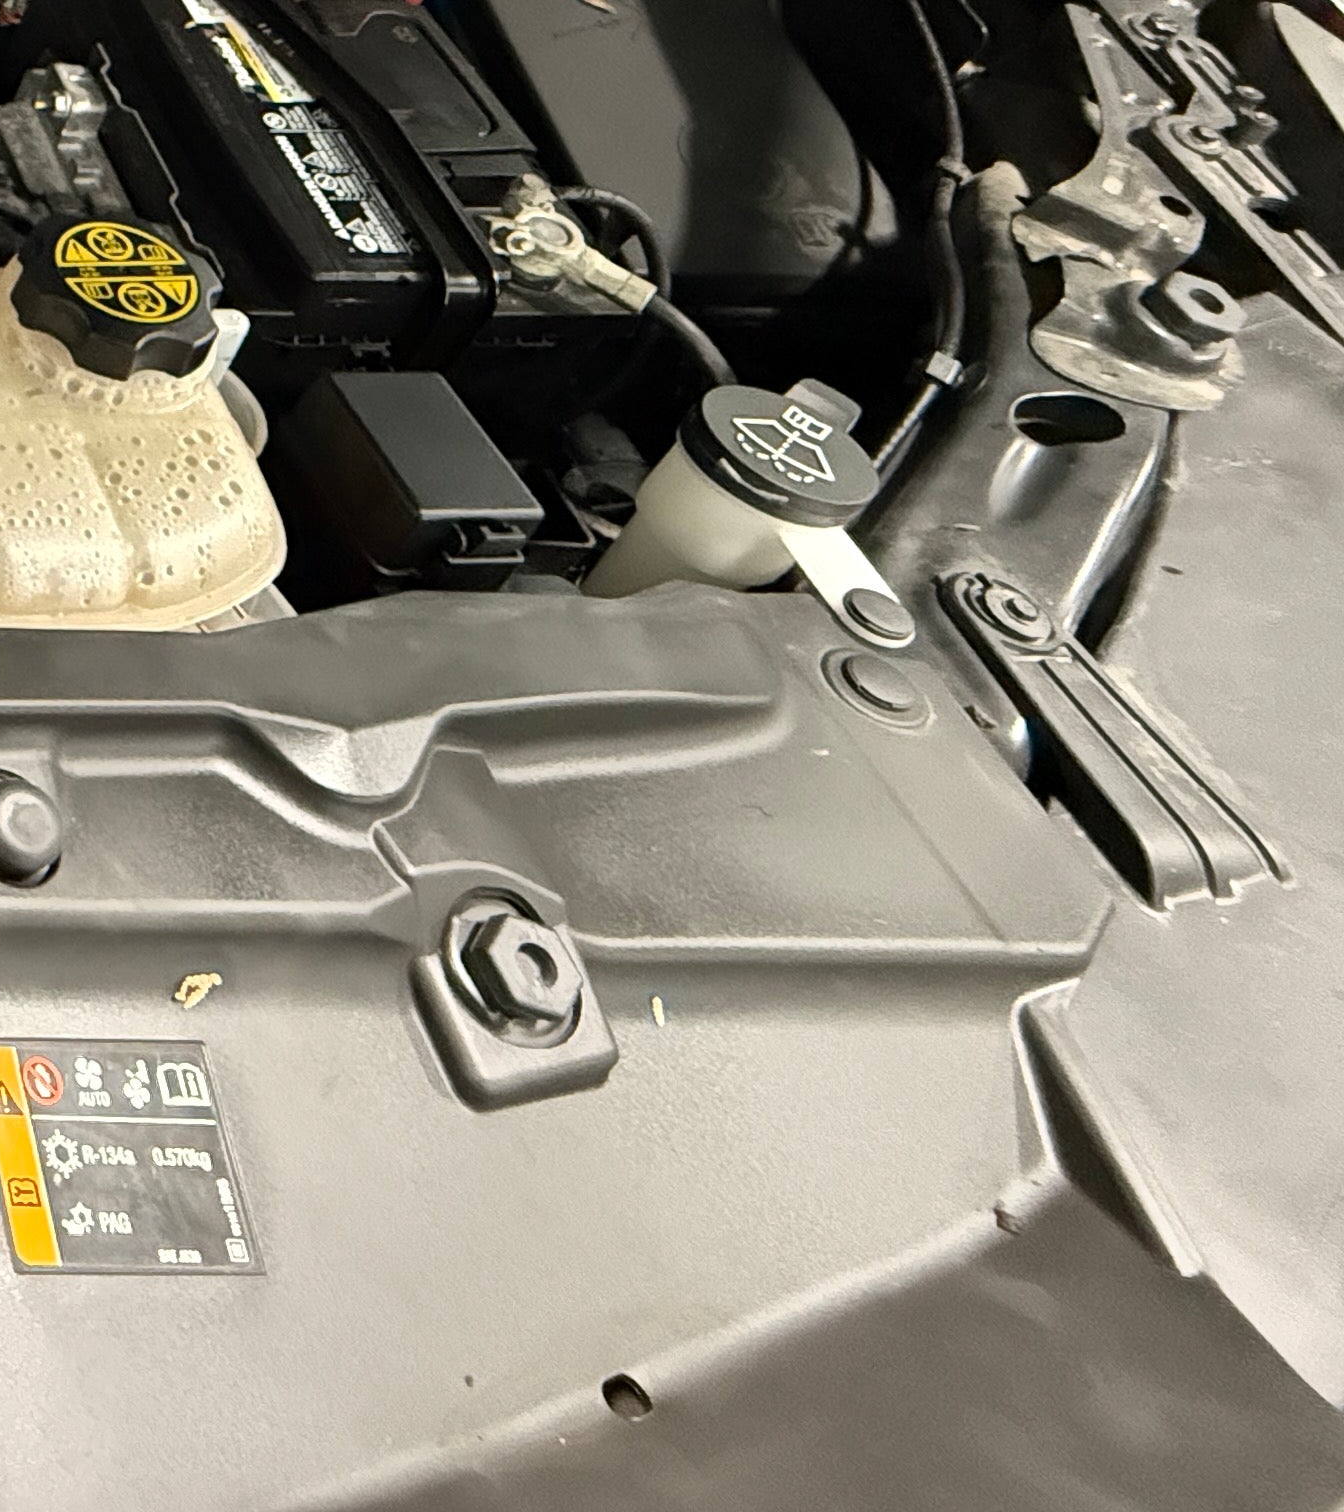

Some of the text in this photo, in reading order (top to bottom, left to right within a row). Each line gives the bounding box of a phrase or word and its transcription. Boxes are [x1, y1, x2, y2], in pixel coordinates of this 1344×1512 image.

[78, 1090, 112, 1108] AUTO
[82, 1144, 213, 1172] R-134a 0.570kg
[98, 1211, 133, 1235] PAG
